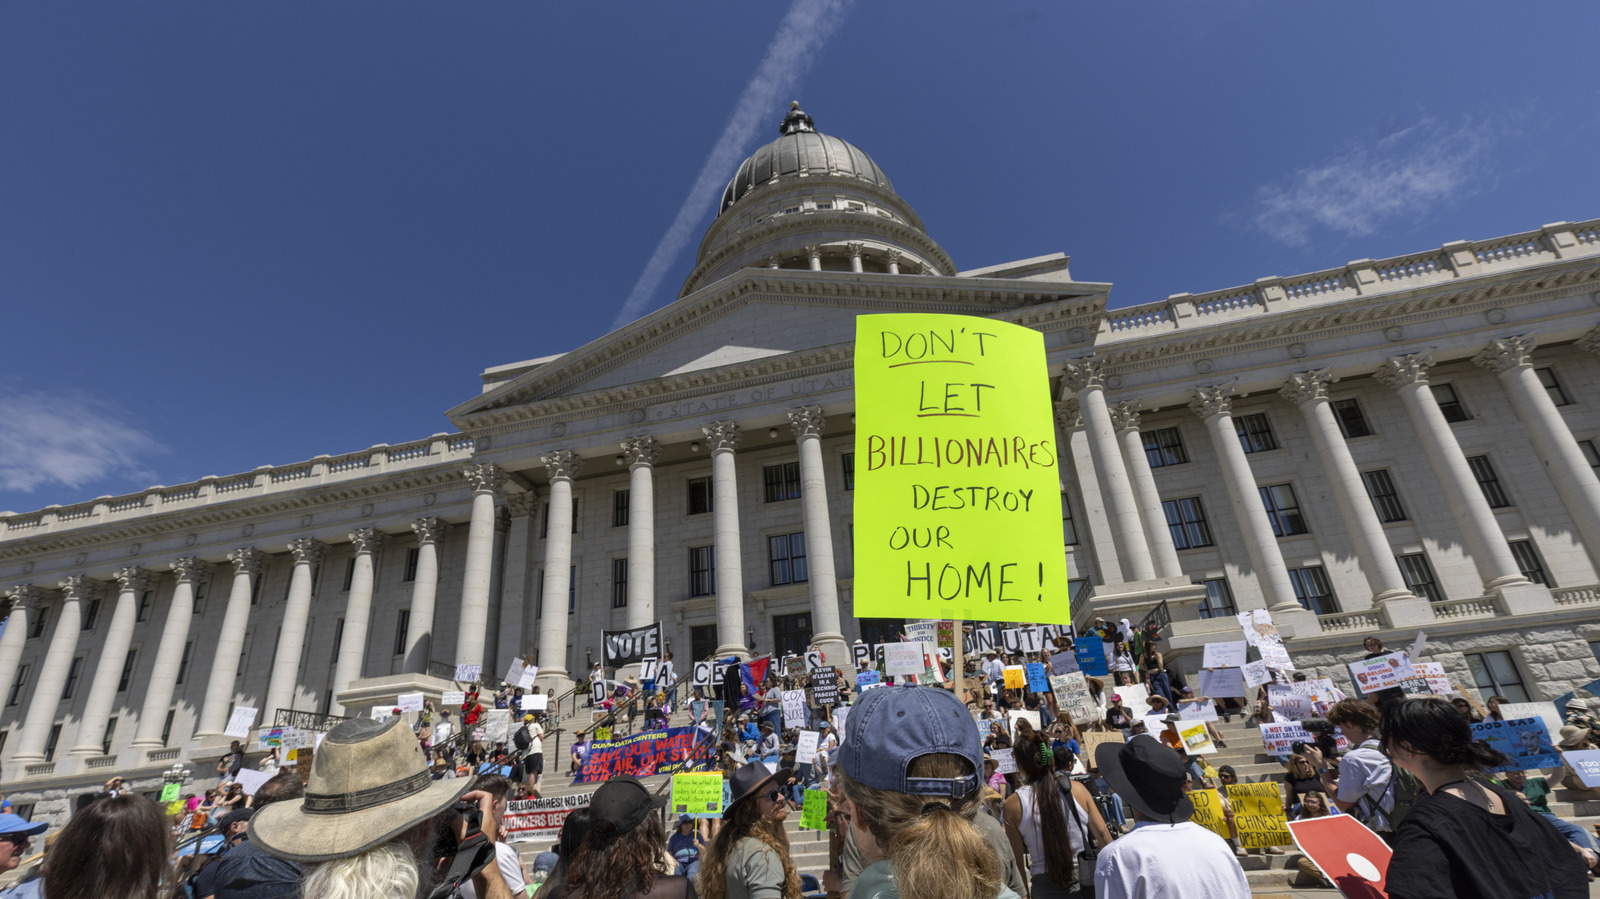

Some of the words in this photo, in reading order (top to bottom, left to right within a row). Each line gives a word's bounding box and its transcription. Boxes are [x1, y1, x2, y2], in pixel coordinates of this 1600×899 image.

[881, 327, 998, 358] DON'T
[670, 393, 738, 417] STATE
[751, 387, 775, 401] OF
[919, 381, 995, 413] LET
[867, 435, 1054, 471] BILLIONAIRES
[911, 483, 1034, 512] DESTROY
[889, 525, 953, 550] OUR
[906, 623, 935, 633] THIRSTY
[605, 627, 657, 660] VOTE
[1362, 657, 1388, 666] SHARKS
[1067, 675, 1081, 683] OUR
[1366, 668, 1393, 677] BELONG
[1071, 683, 1084, 691] SAVE
[1294, 679, 1323, 688] RUMP
[1361, 683, 1380, 691] GREAT
[783, 690, 805, 703] COX
[1281, 699, 1303, 708] NOT
[1473, 721, 1502, 731] OOD
[1507, 717, 1536, 727] BAD
[615, 740, 632, 748] DATA
[633, 732, 668, 744] CENTERS
[590, 747, 623, 765] SAVE
[624, 742, 652, 757] OUR
[1277, 745, 1291, 753] NATU
[582, 762, 610, 775] OUR
[640, 750, 667, 767] OUR
[1228, 784, 1251, 797] KEVIN
[1250, 782, 1279, 799] THINKS
[509, 796, 563, 812] BILLIONAIRES!
[565, 795, 576, 807] NO
[577, 792, 594, 805] DAT
[1231, 801, 1246, 814] I'M
[1258, 799, 1269, 814] A
[501, 813, 547, 830] WORKERS
[1235, 814, 1287, 830] CHINESE
[1238, 832, 1292, 849] OPERATIVE
